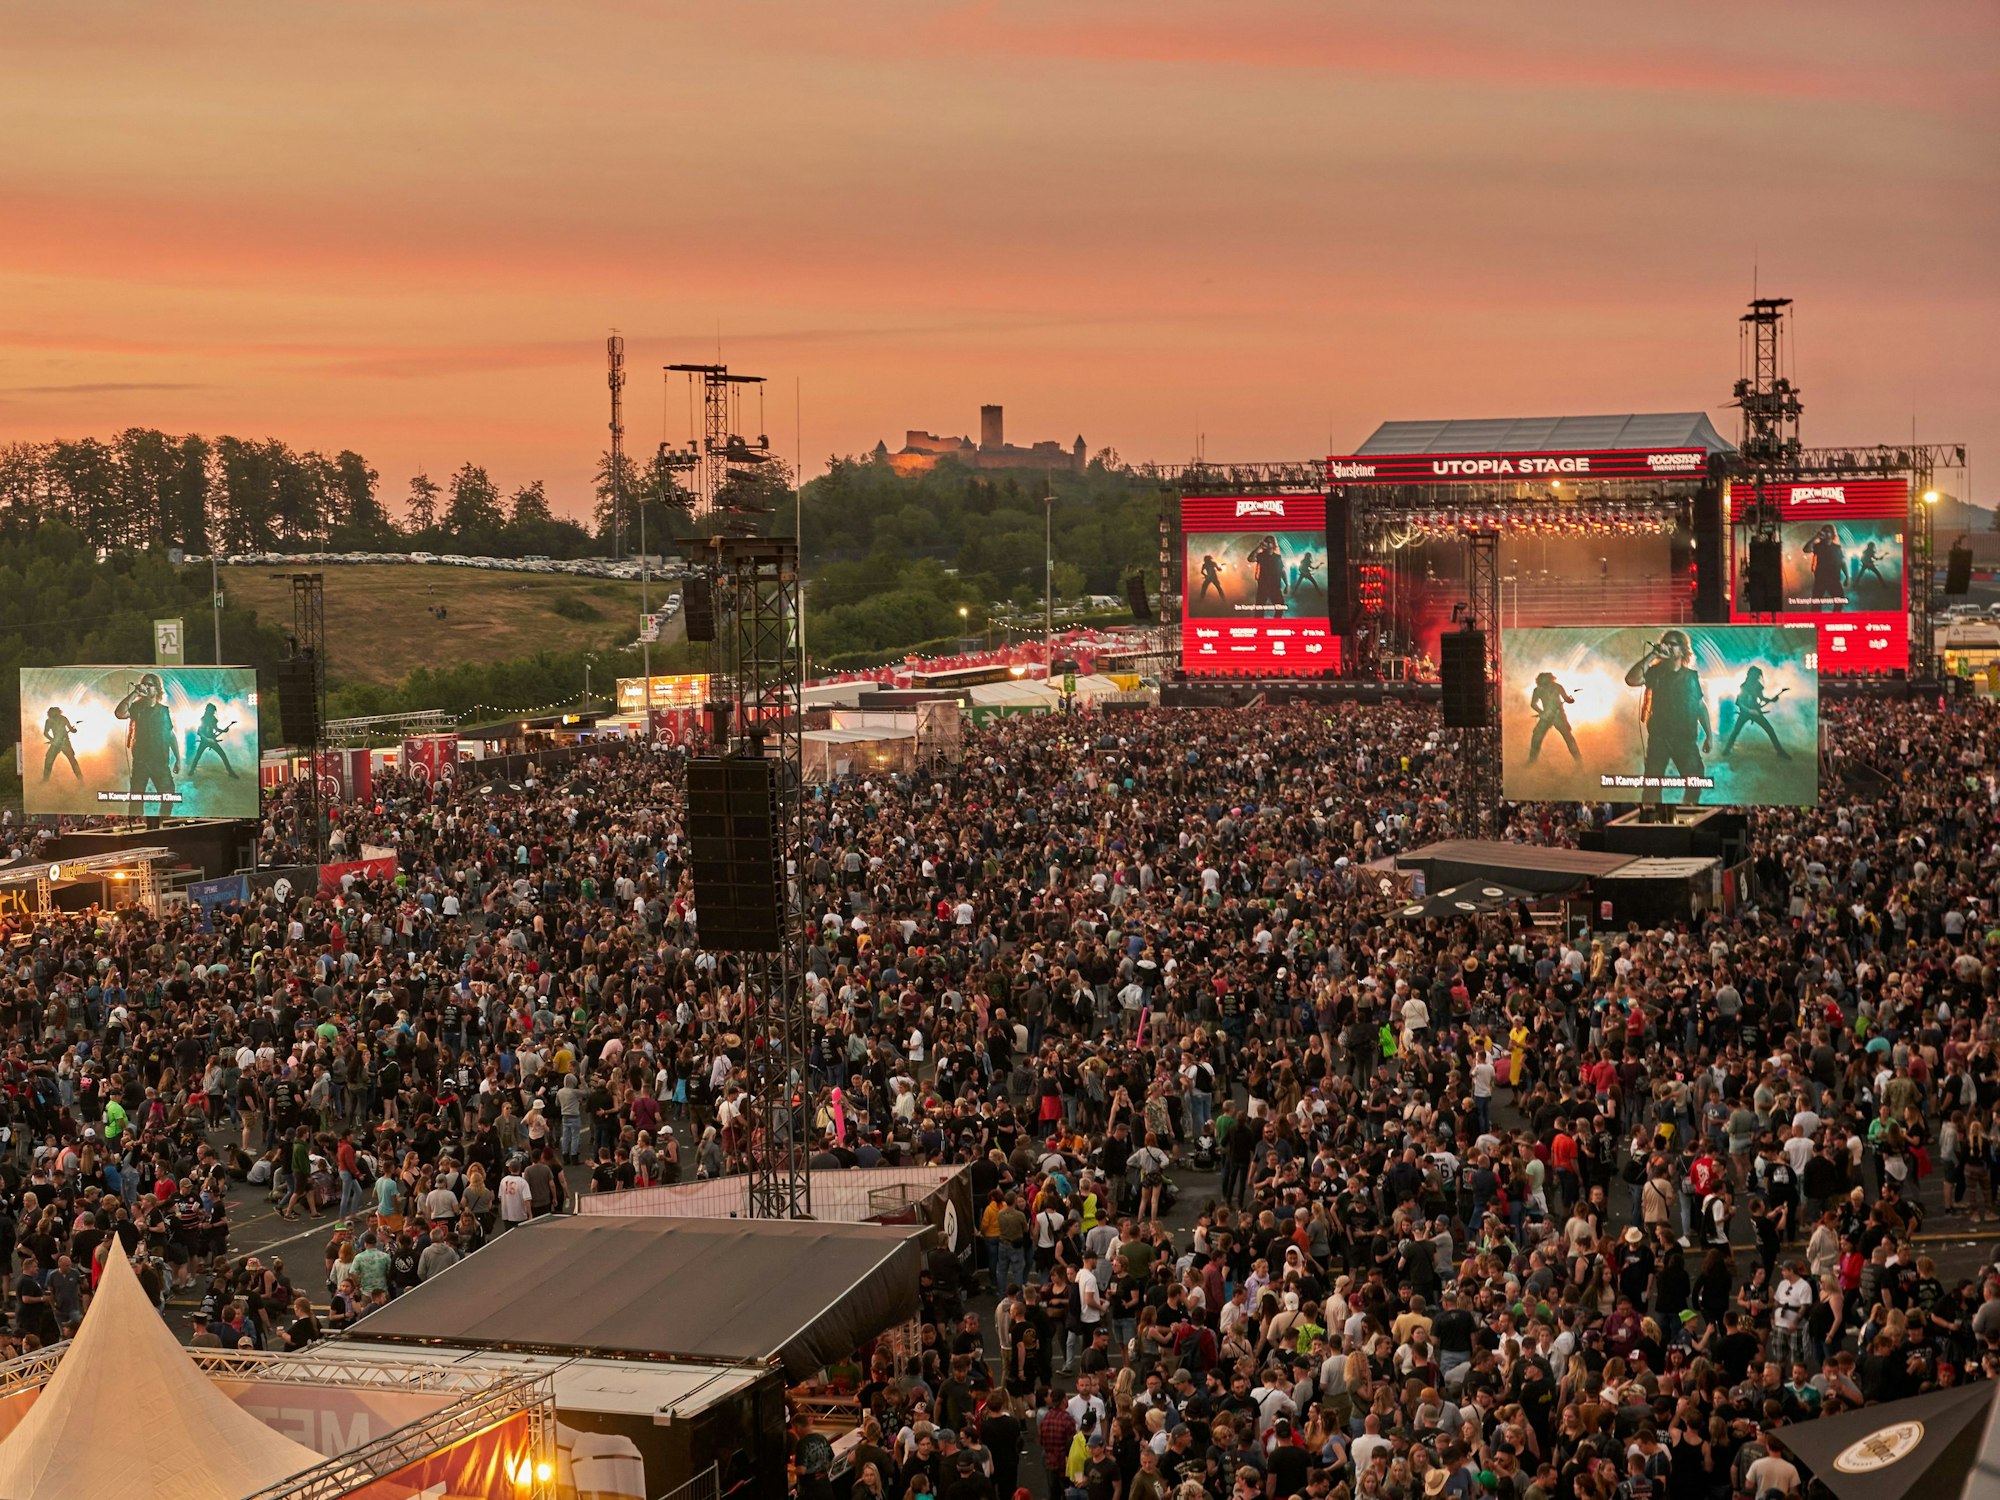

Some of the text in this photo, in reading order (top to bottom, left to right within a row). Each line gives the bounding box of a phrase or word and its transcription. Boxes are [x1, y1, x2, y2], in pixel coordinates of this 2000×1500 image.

[1432, 457, 1590, 475] UTOPIA STAGE
[1646, 453, 1702, 465] ROCKSTAR
[1332, 461, 1376, 479] Warsteiner
[1790, 487, 1815, 505] ROCK
[1821, 486, 1846, 504] RING
[1235, 500, 1258, 517] ROCK
[1263, 500, 1285, 517] RING
[1600, 775, 1714, 787] Im Kampf um unser Klima
[98, 792, 108, 800] Im
[108, 792, 131, 801] Kampf
[162, 793, 182, 801] Klima
